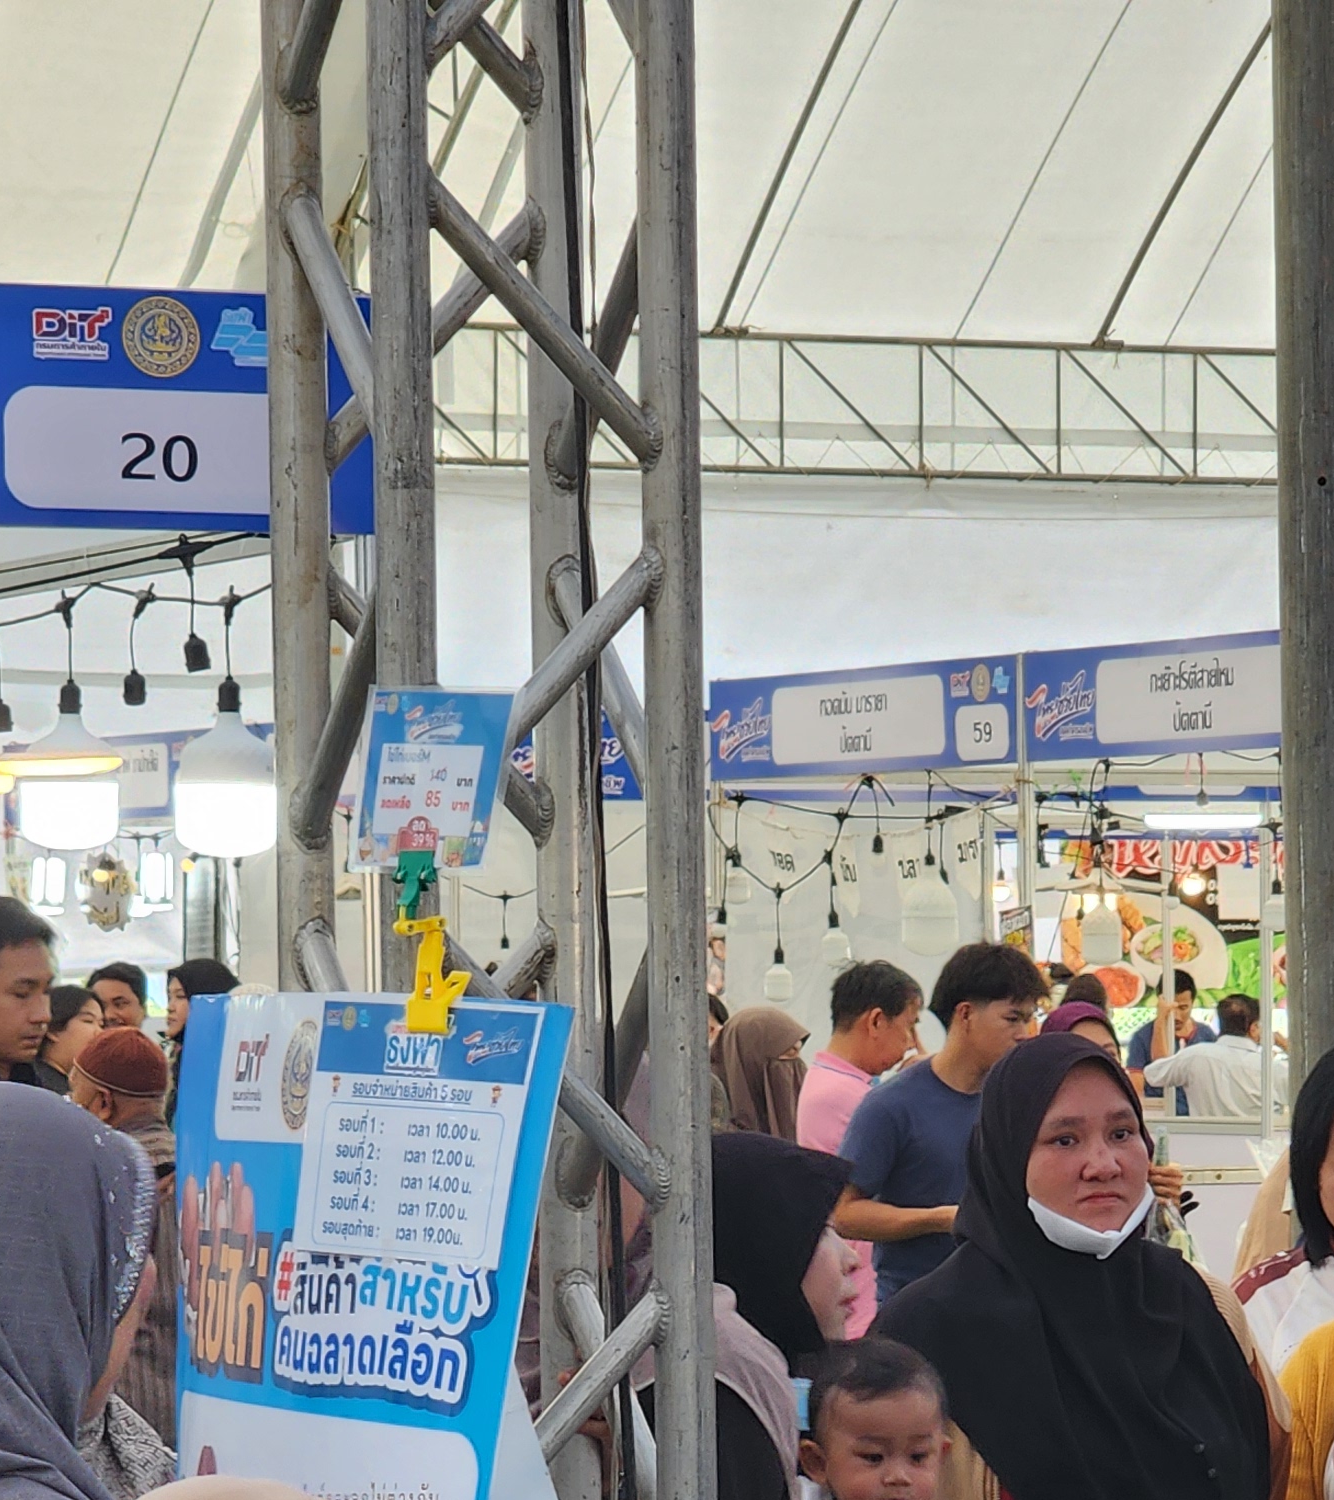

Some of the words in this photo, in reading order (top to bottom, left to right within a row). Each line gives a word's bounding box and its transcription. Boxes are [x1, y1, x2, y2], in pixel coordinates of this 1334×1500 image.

[120, 432, 199, 482] 20
[972, 721, 993, 744] 59
[424, 789, 442, 808] 85
[440, 1086, 448, 1100] 5
[450, 1089, 473, 1103] รอบ
[407, 1122, 430, 1138] เวลา
[435, 1122, 468, 1141] 10.00
[403, 1149, 426, 1164] เวลา
[431, 1148, 463, 1168] 12.00
[400, 1175, 423, 1191] เวลา
[427, 1174, 459, 1194] 14.00
[397, 1202, 420, 1217] เวลา
[424, 1201, 455, 1220] 17.00
[395, 1227, 417, 1242] เวลา
[278, 1319, 462, 1394] คนฉลาดเลือก
